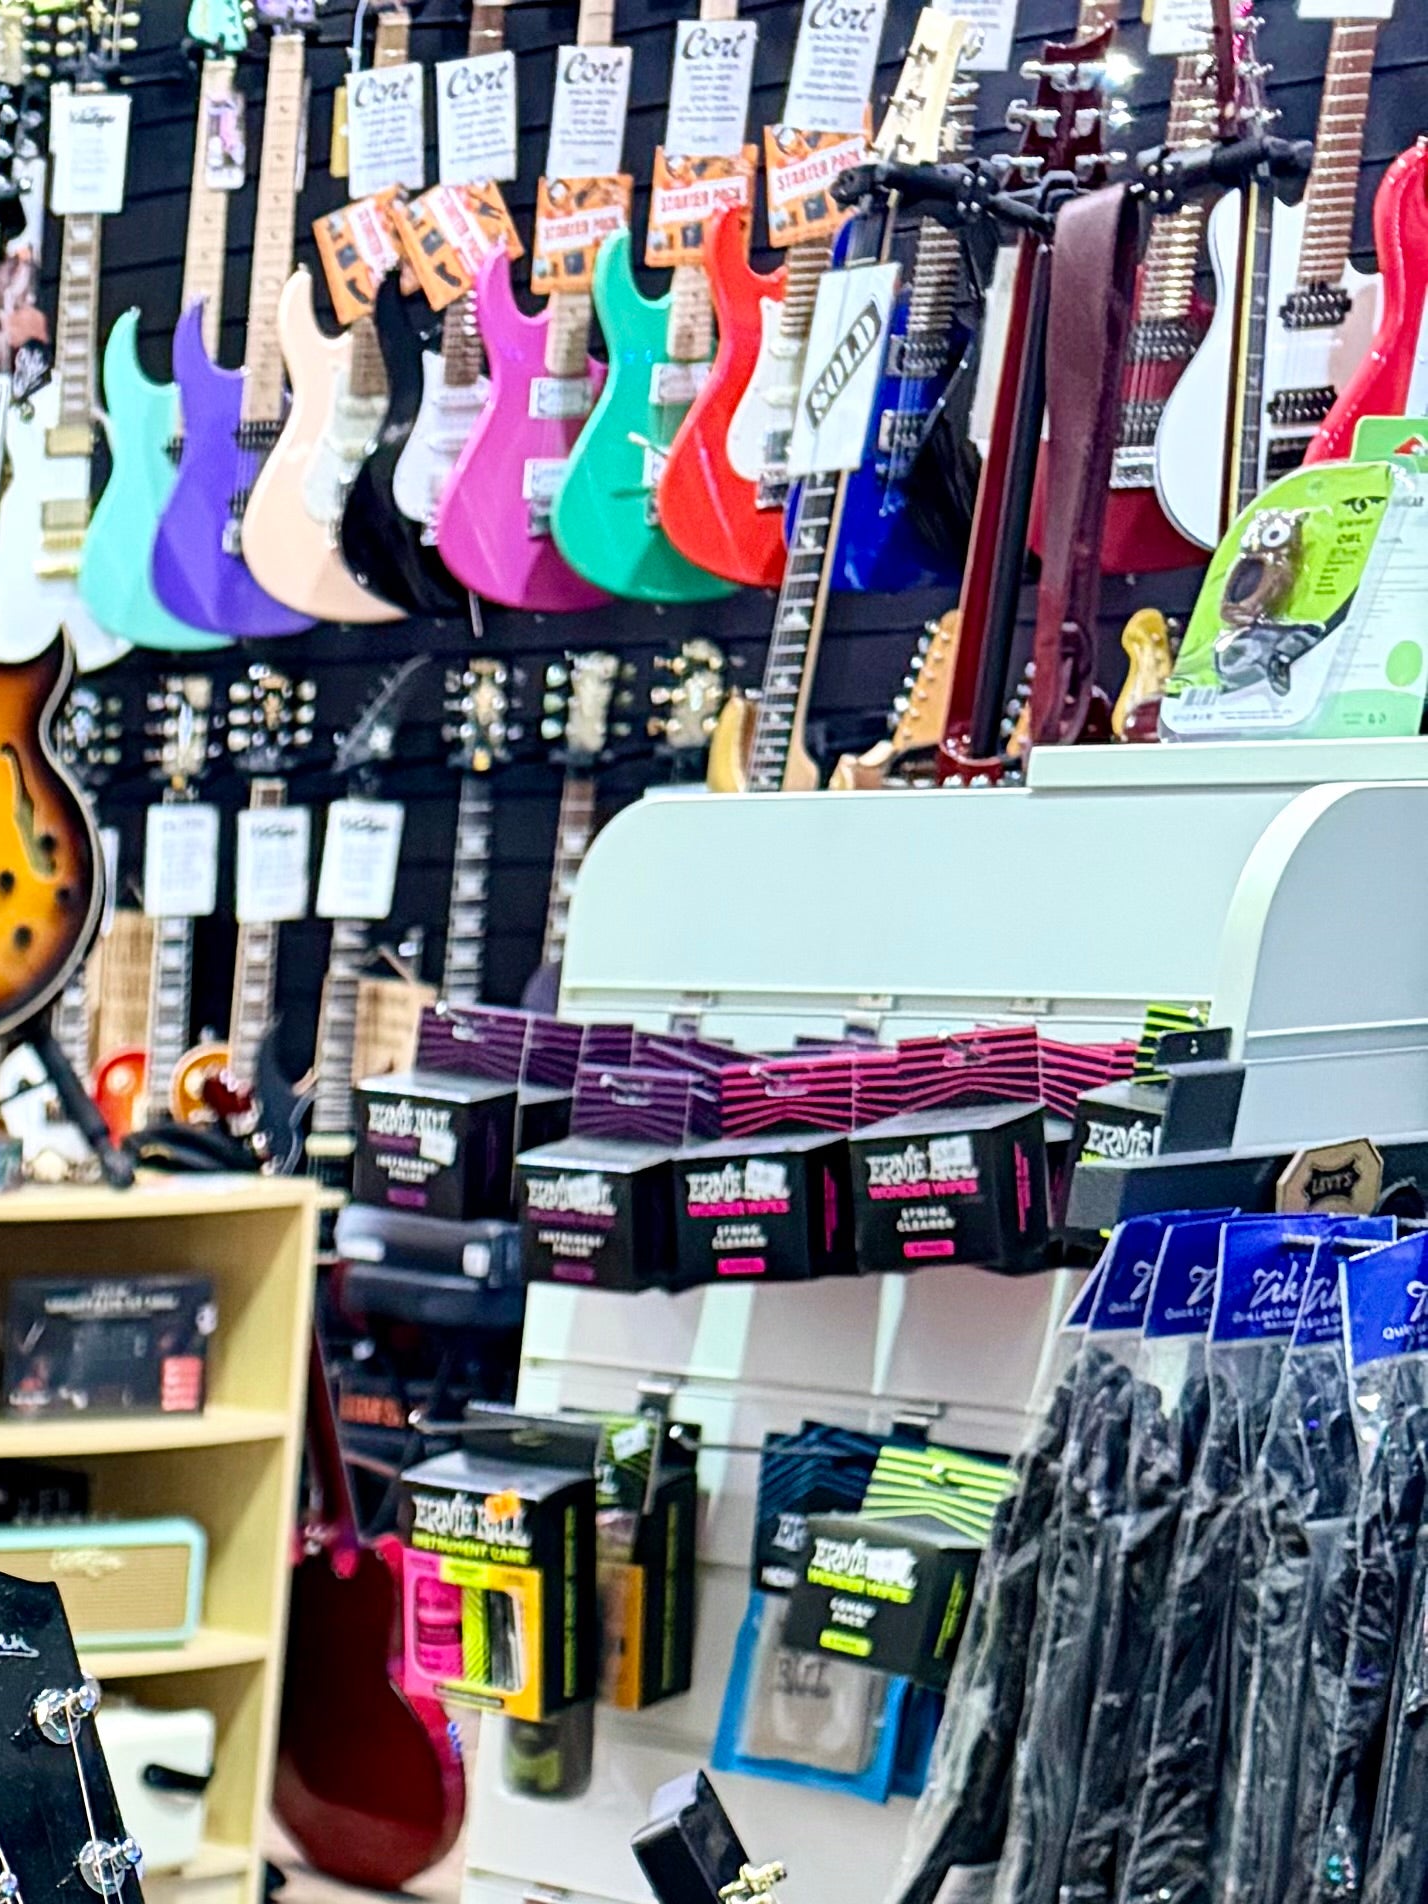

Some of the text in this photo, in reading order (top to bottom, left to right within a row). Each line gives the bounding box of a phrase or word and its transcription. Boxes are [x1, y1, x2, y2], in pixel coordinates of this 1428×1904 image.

[808, 0, 876, 32] Cort
[682, 27, 747, 60] Cort
[447, 62, 509, 99] Cort
[564, 52, 624, 84] Cort
[354, 73, 414, 107] Cort
[659, 191, 709, 213] STARTER
[1085, 1119, 1152, 1158] ERNIE
[866, 1143, 928, 1186] ERNIE
[685, 1161, 744, 1205] ERNIE
[412, 1491, 473, 1538] ERNIE
